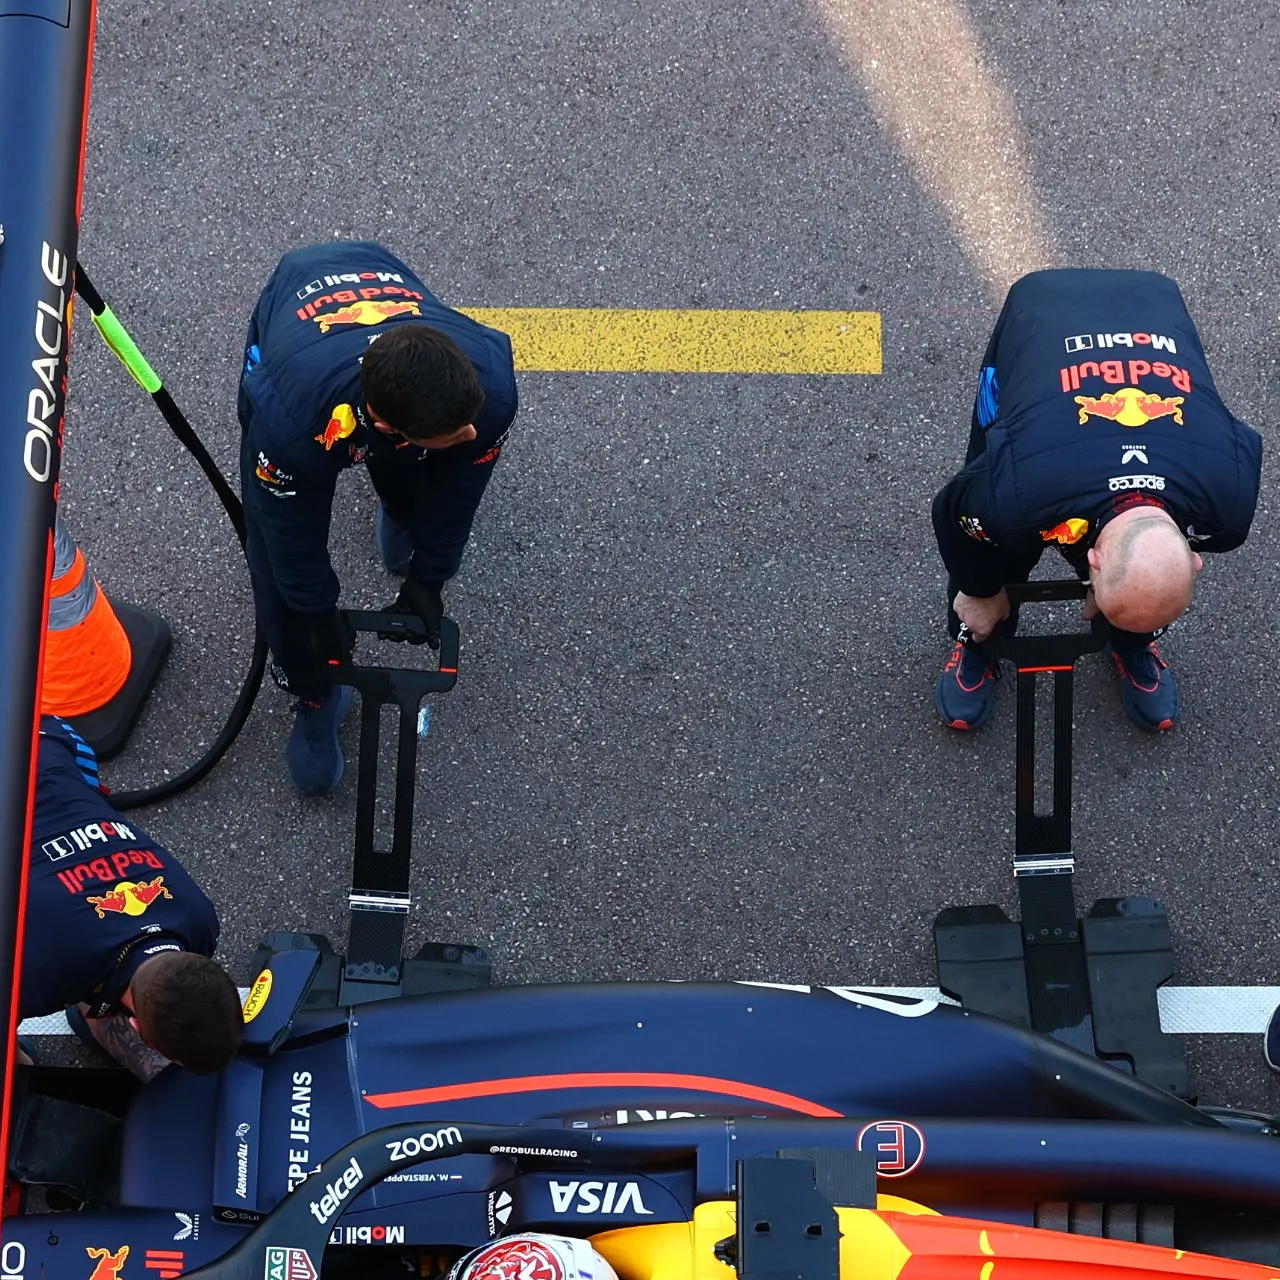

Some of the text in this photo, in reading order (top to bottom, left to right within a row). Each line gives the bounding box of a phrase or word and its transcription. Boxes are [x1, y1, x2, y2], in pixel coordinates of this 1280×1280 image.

[324, 272, 404, 287] Mobil
[296, 289, 358, 321] Bull
[1097, 332, 1177, 354] Mobil
[23, 240, 68, 482] ORACLE
[1060, 360, 1193, 393] Red Bull
[1108, 475, 1166, 491] sparco
[70, 819, 136, 851] Mobil
[56, 849, 165, 894] Red Bull
[244, 983, 265, 1018] RAUCH
[288, 1071, 313, 1192] PE JEANS
[385, 1126, 464, 1161] zoom
[875, 1124, 906, 1171] E
[489, 1145, 578, 1158] @REDBULLRACING
[309, 1157, 364, 1224] telcel
[382, 1173, 449, 1183] M. VERSTAPPE
[549, 1181, 654, 1214] VISA
[346, 1226, 404, 1244] Mobil
[144, 1249, 184, 1279] ll
